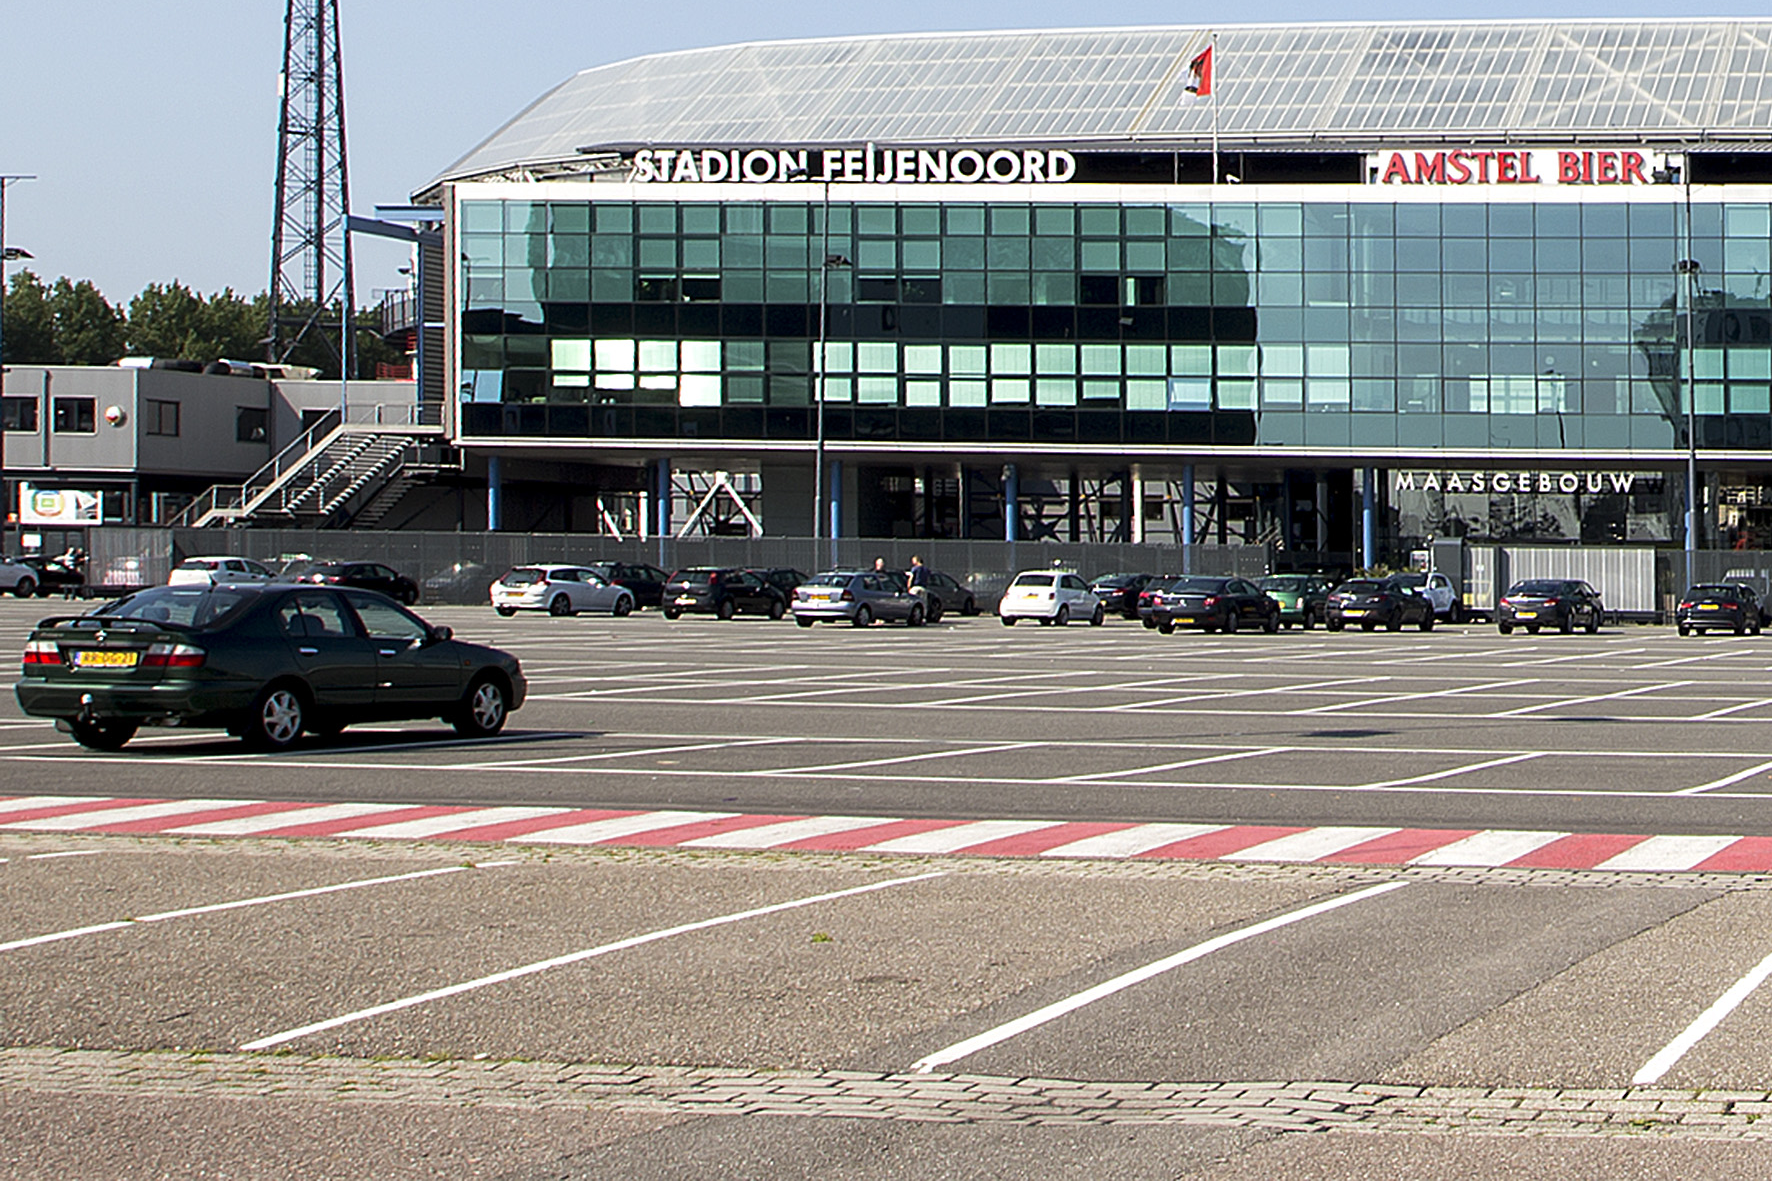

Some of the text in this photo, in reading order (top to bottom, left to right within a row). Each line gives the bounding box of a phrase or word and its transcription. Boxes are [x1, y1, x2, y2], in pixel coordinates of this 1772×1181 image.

[633, 149, 1076, 182] STADION FEIJENOORD
[1382, 149, 1651, 183] AMSTEL BIER
[1395, 472, 1635, 494] MAASGEBOUW
